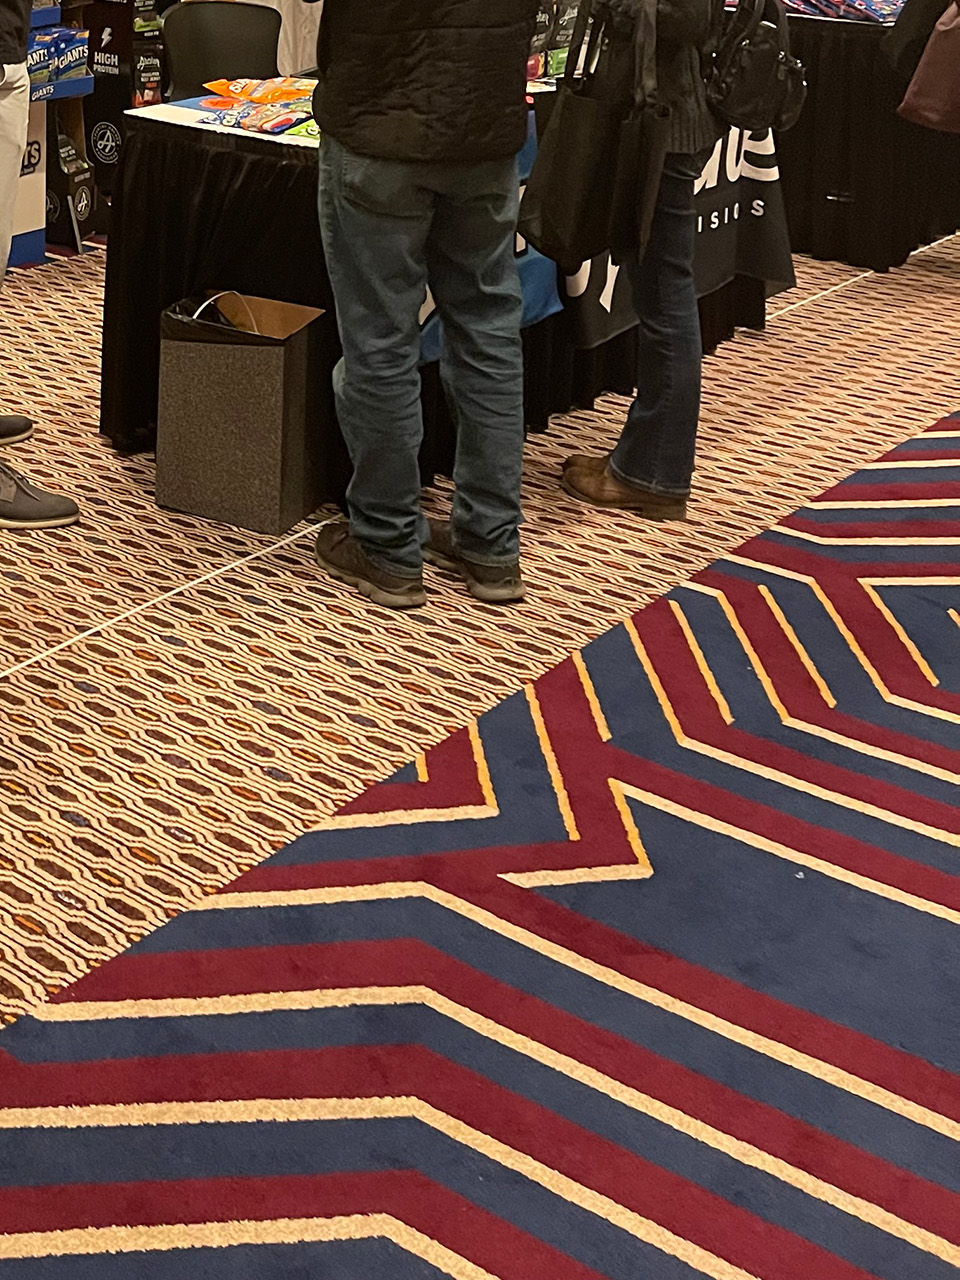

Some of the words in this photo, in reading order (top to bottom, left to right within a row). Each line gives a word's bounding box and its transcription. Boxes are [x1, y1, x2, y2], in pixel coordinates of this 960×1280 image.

[58, 45, 89, 69] GIANTS
[94, 51, 119, 66] HIGH
[31, 85, 54, 101] GIANTS
